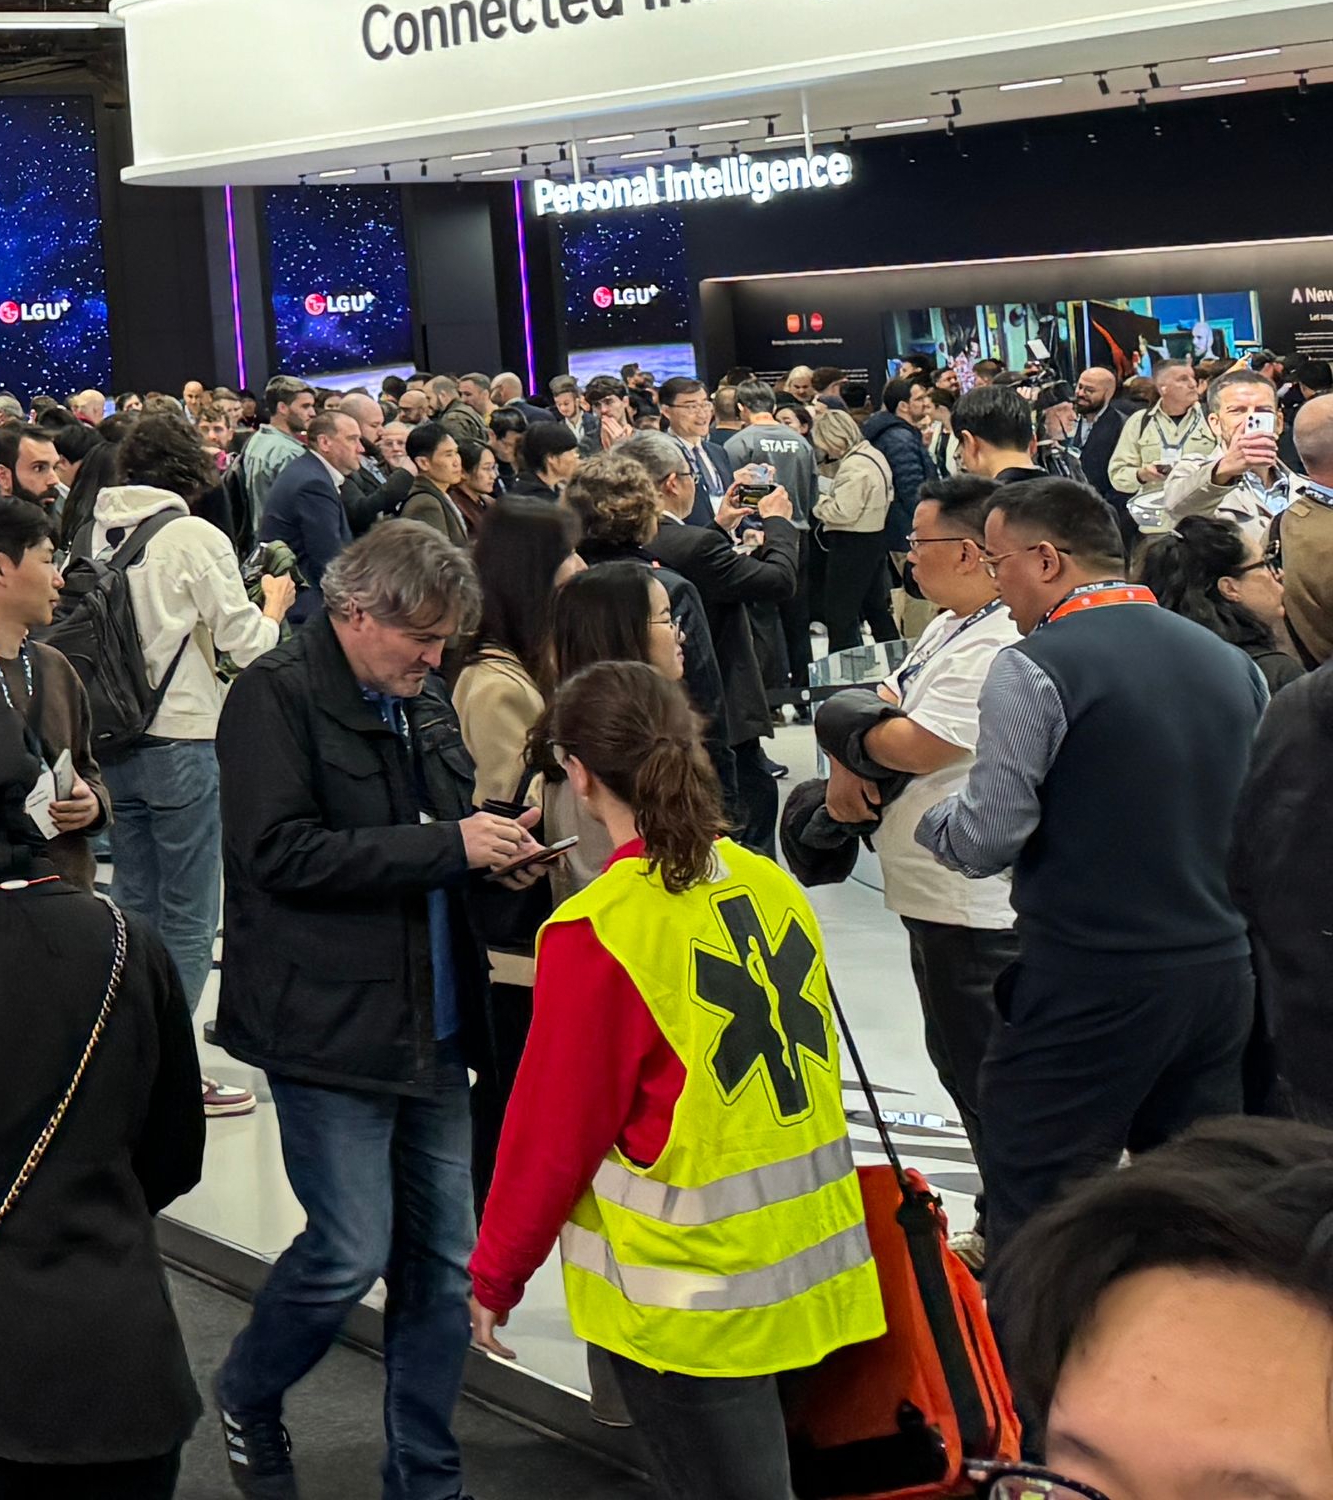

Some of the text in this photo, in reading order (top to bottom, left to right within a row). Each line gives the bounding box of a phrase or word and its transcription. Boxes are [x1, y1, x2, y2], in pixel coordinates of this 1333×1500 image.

[534, 152, 852, 216] Personal Intelligence
[326, 291, 375, 314] LGU+
[612, 283, 660, 306] LGU+
[1291, 288, 1303, 304] A
[21, 299, 72, 322] LGU+
[759, 438, 799, 453] STAFF
